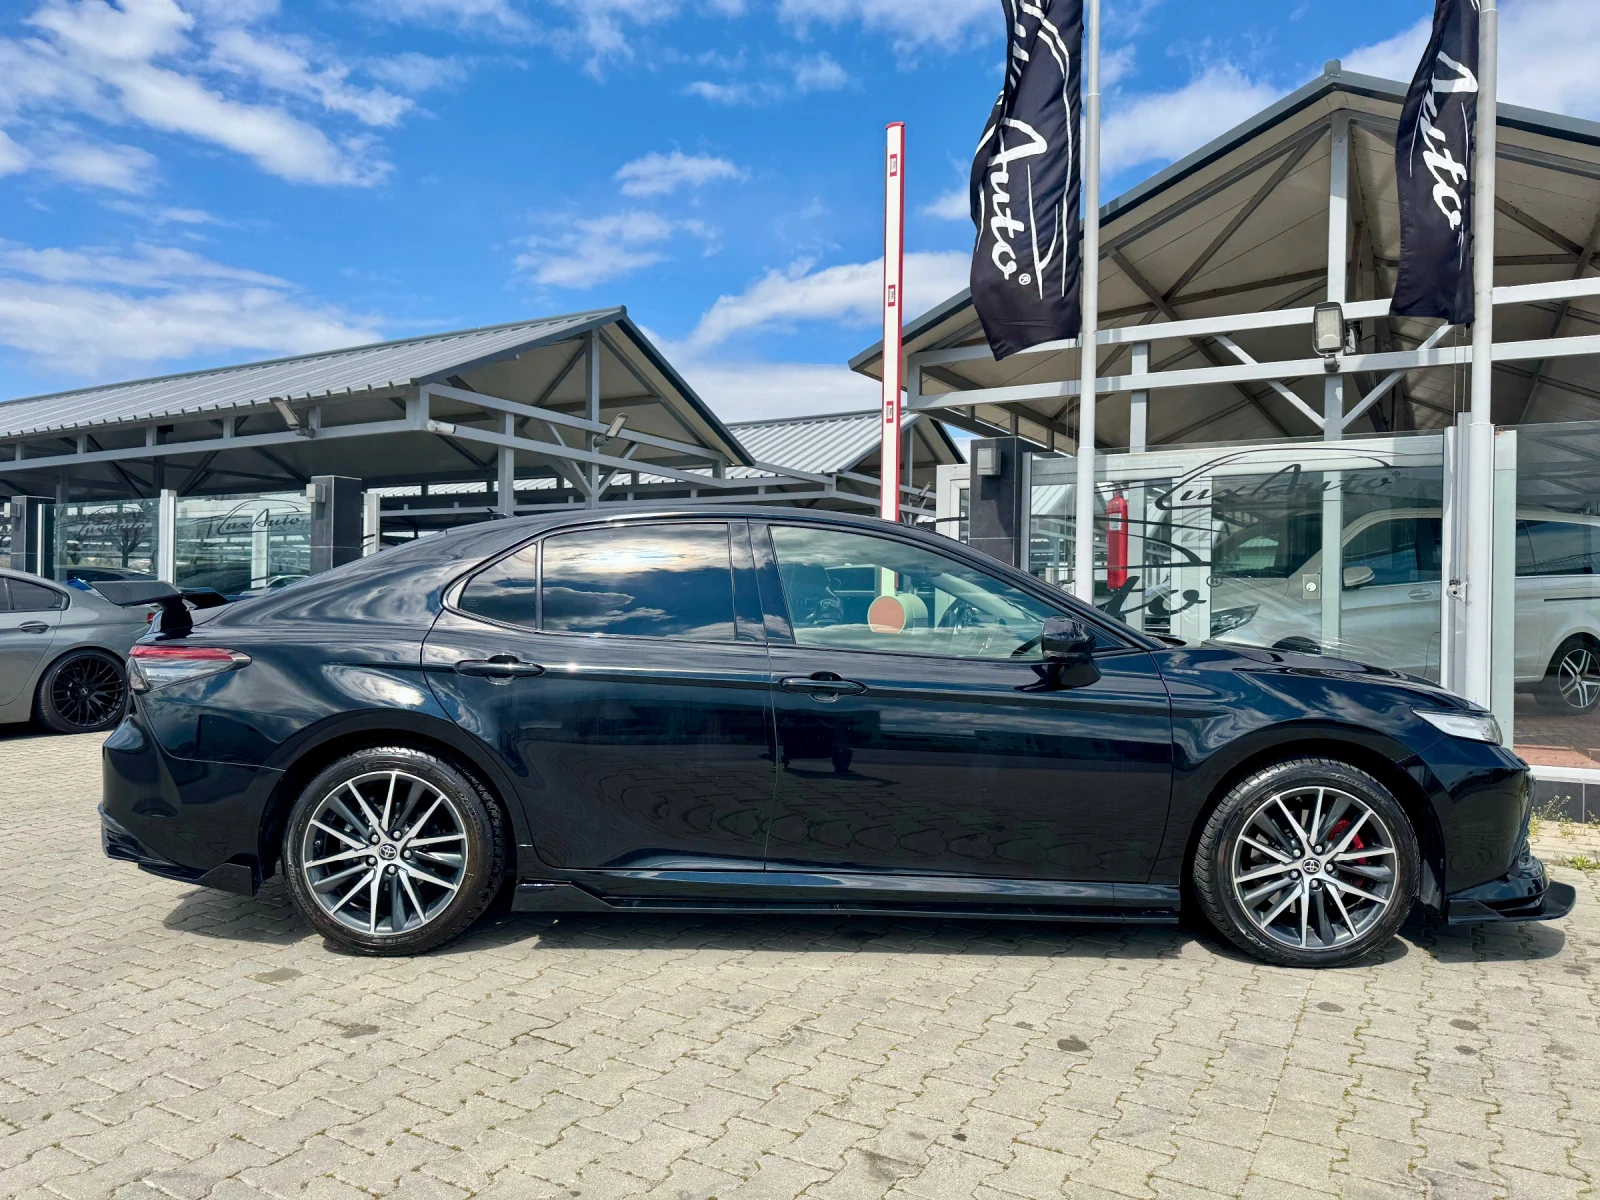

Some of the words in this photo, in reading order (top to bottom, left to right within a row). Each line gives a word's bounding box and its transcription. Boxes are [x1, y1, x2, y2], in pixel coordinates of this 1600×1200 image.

[986, 117, 1048, 280] Auto
[1419, 50, 1478, 231] Auto
[1246, 463, 1393, 498] Auto
